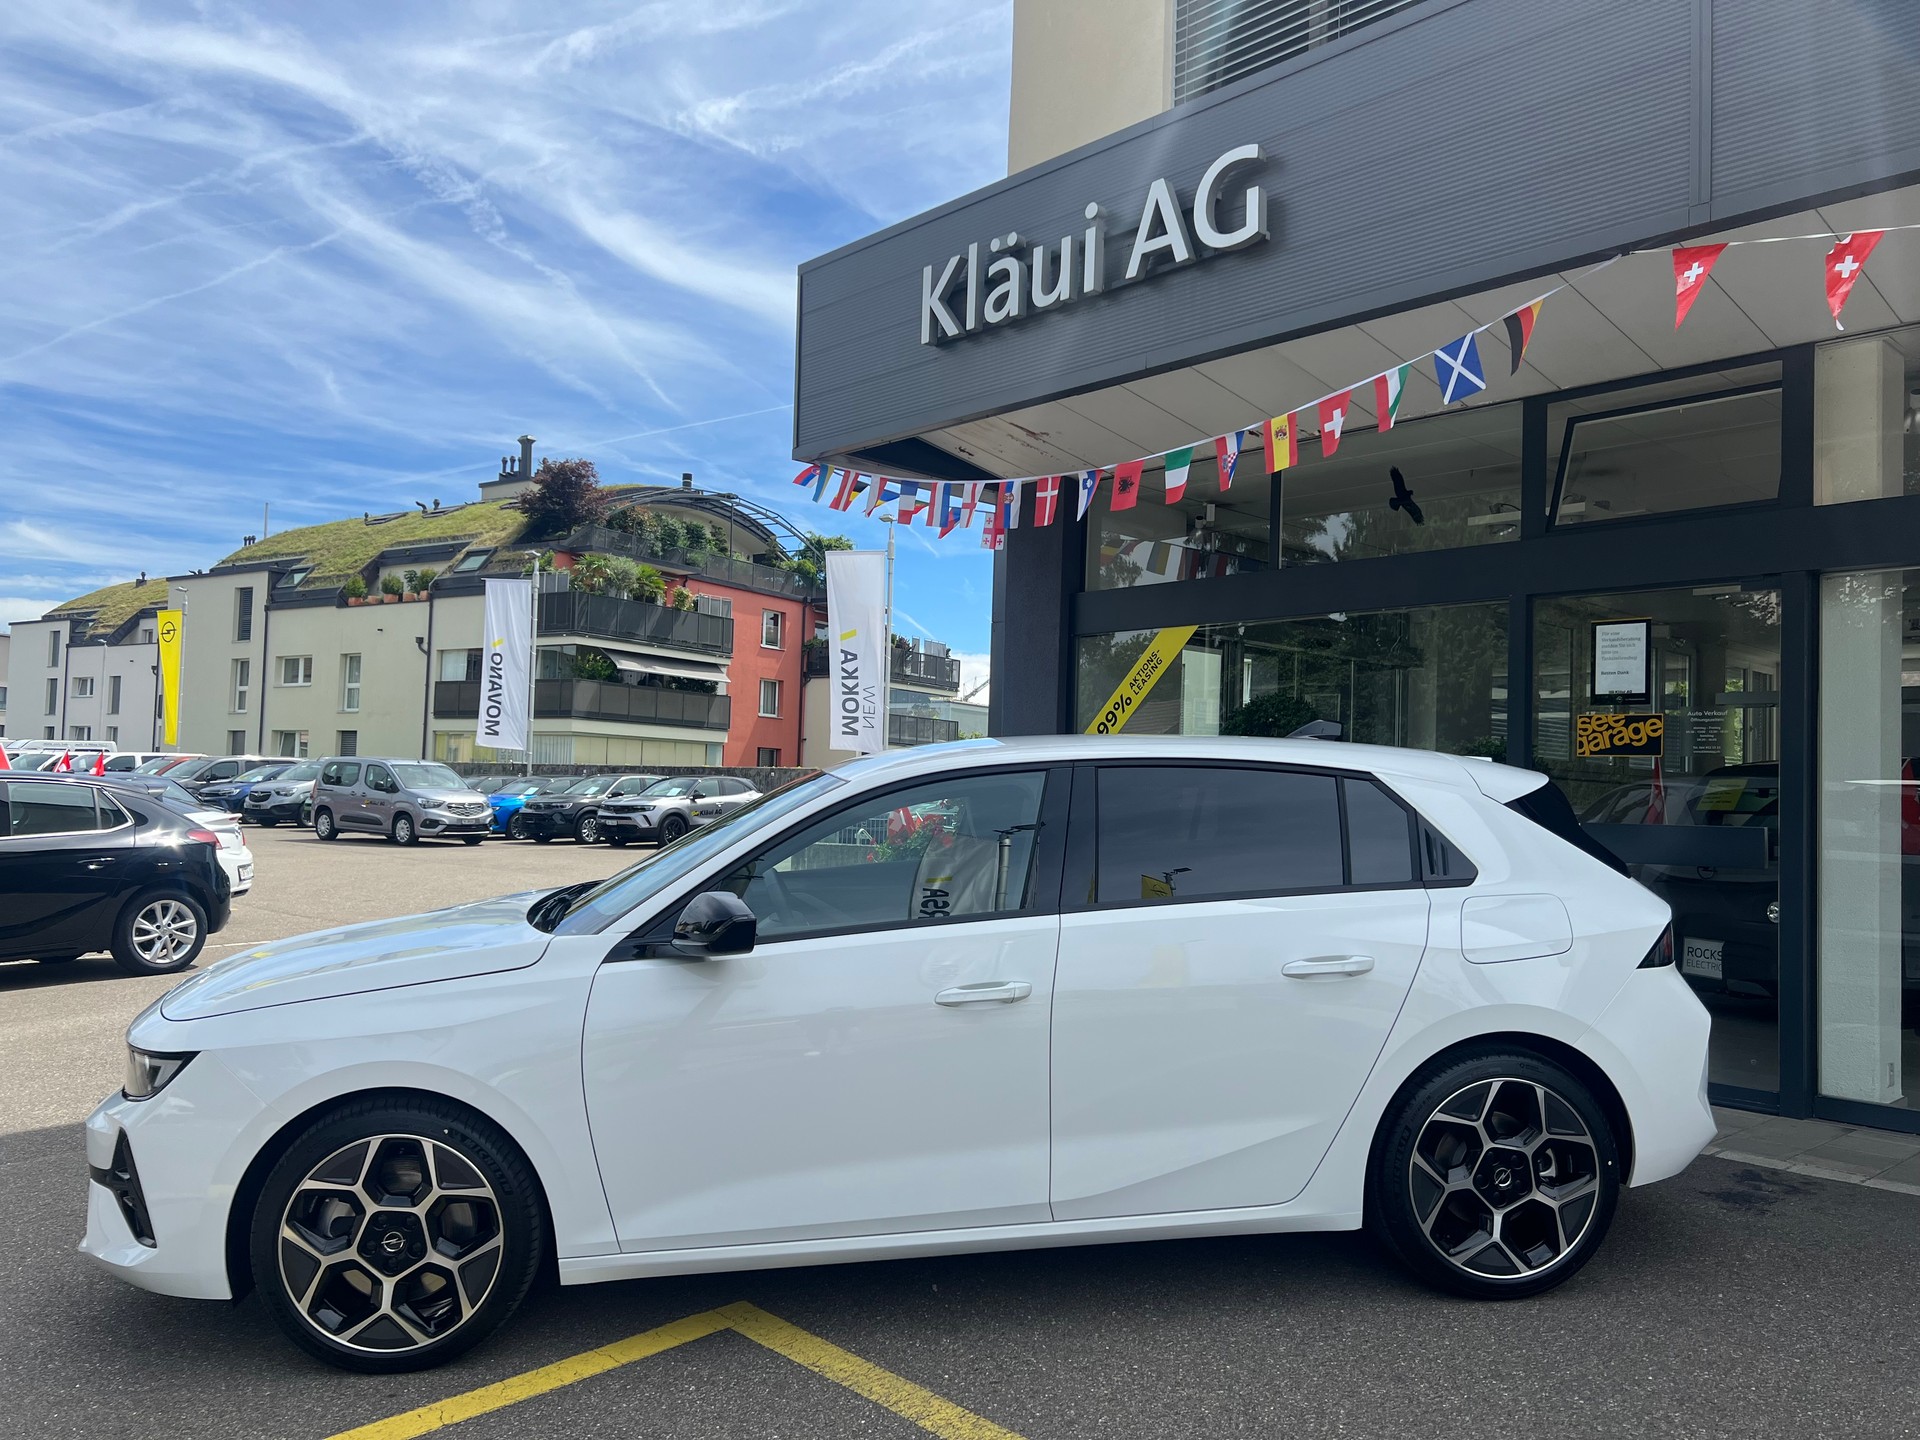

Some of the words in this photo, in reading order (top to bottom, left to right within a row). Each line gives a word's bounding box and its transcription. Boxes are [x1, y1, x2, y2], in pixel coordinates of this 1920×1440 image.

[920, 201, 1104, 346] Kläui
[1125, 143, 1270, 281] AG
[1129, 649, 1160, 690] AKTIONS-
[1132, 658, 1163, 696] LEASING
[1578, 715, 1625, 736] see
[1578, 718, 1663, 756] garage
[1687, 946, 1723, 961] ROCKS
[463, 1137, 513, 1194] MICHELIN
